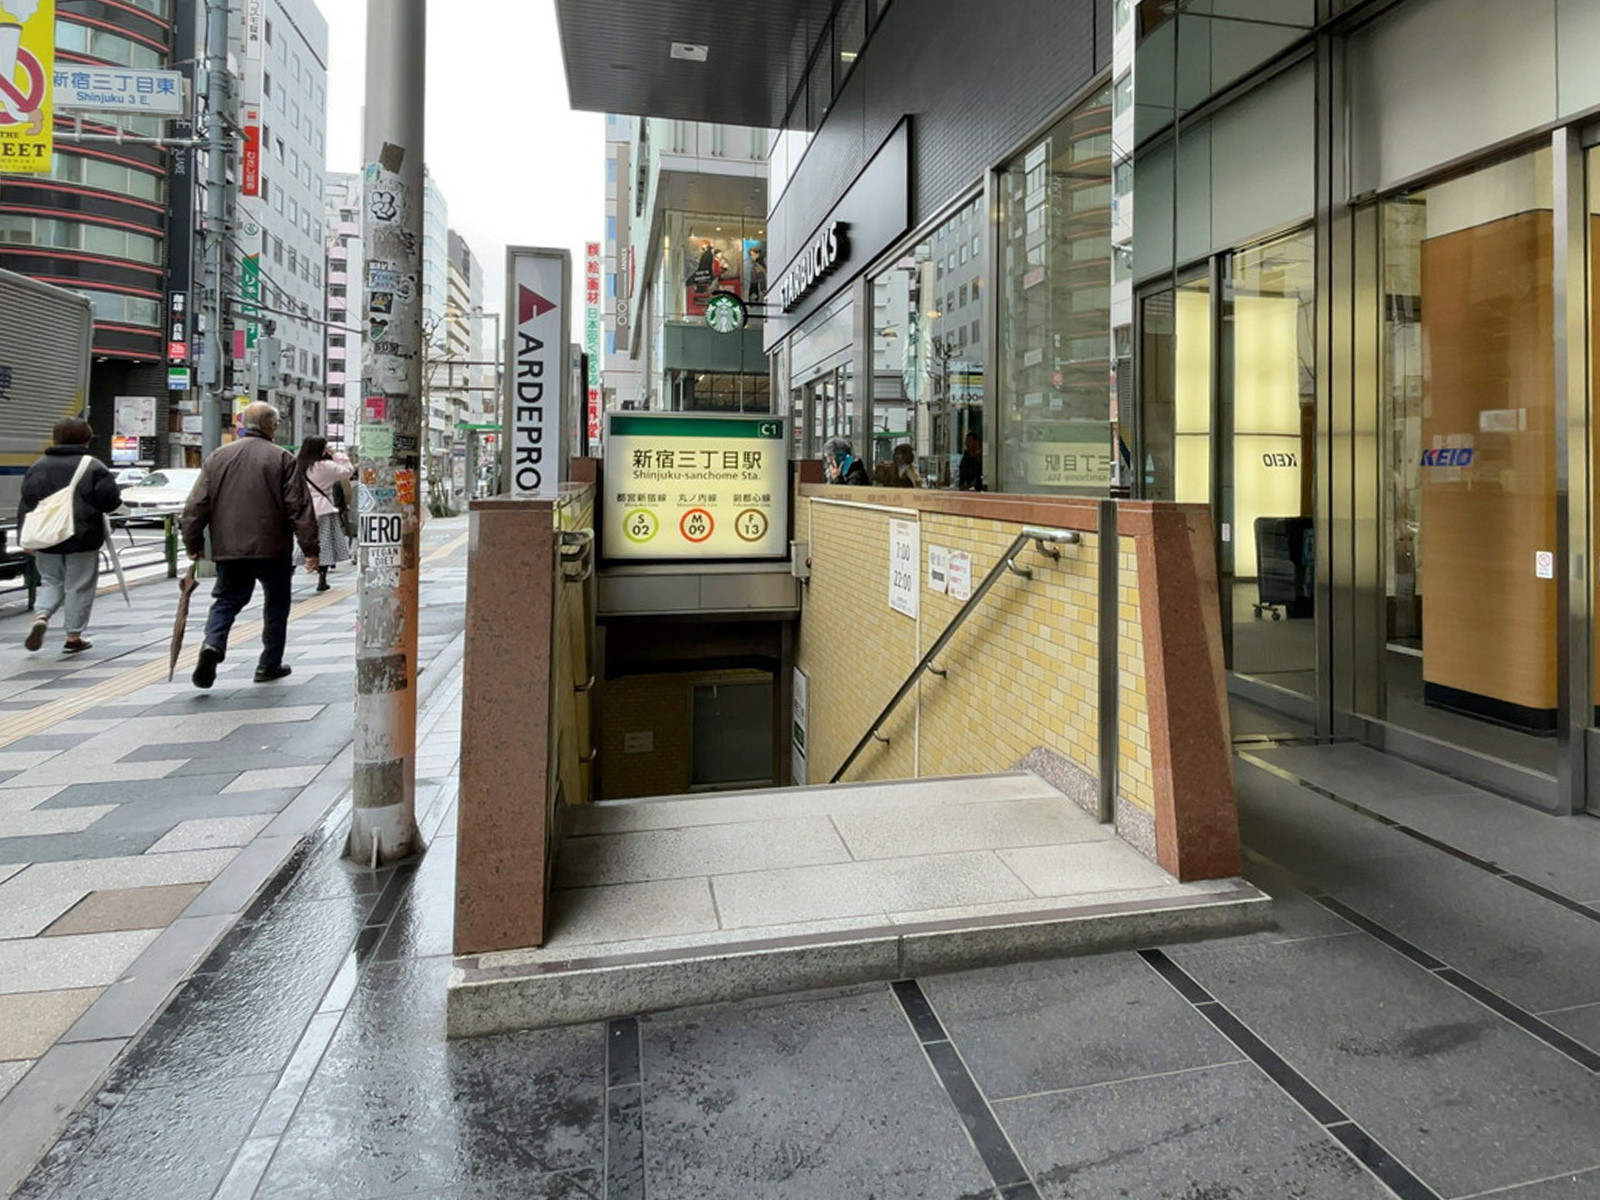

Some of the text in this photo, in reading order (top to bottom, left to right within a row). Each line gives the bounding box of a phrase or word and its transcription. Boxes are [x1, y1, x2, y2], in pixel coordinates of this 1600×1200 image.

[54, 71, 176, 94] 新宿三丁目東
[77, 91, 149, 105] Shinjuku 3 E
[2, 143, 46, 157] EET
[780, 221, 837, 313] STARBUCKS
[515, 331, 544, 491] ARDEPRO
[761, 424, 776, 435] C1
[633, 450, 762, 469] 新宿三丁目駅
[1420, 449, 1473, 466] KEIO
[633, 471, 760, 481] Shinjuku-sanchome Sta.
[616, 493, 666, 502] 都営新宿線
[679, 493, 717, 502] 丸ノ内線
[733, 493, 770, 502] 副都心線
[637, 514, 645, 524] S
[691, 514, 703, 523] M
[748, 514, 754, 523] F
[361, 515, 401, 543] NERO
[632, 525, 650, 536] 02
[688, 525, 706, 535] 09
[745, 525, 759, 535] 13
